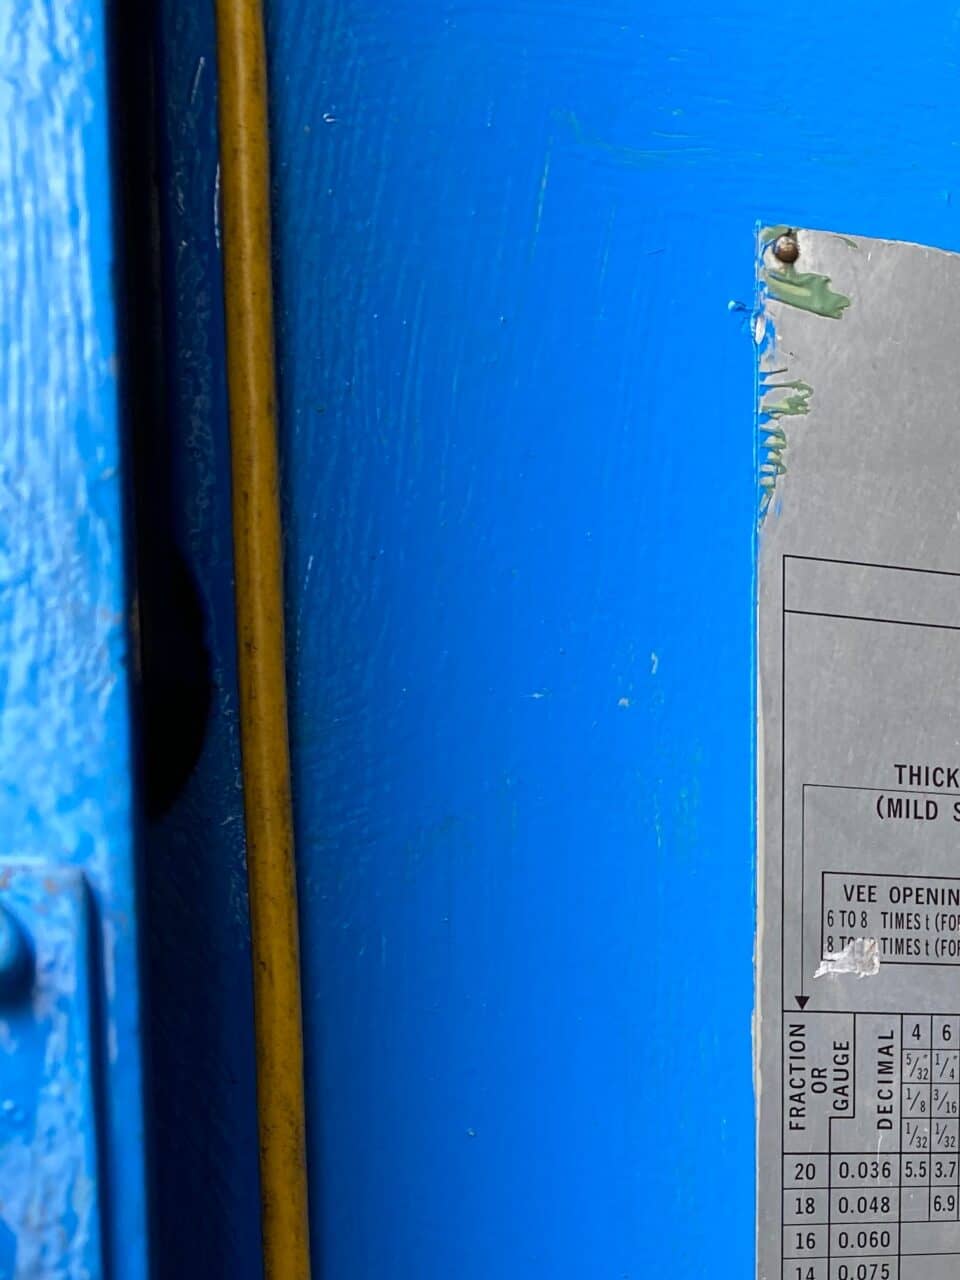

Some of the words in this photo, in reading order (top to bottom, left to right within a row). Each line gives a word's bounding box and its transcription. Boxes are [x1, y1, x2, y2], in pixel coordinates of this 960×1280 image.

[876, 795, 938, 820] (MILD
[843, 884, 877, 903] VEE
[827, 909, 834, 927] 6
[839, 910, 856, 928] TO
[860, 910, 868, 928] 8
[880, 911, 921, 930] TIMES
[925, 913, 930, 931] t
[827, 935, 834, 953] 8
[880, 937, 921, 956] TIMES
[925, 939, 930, 957] t
[912, 1023, 921, 1040] 4
[942, 1024, 951, 1041] 6
[789, 1024, 806, 1130] FRACTION
[811, 1067, 828, 1094] OR
[832, 1041, 849, 1111] GAUGE
[876, 1030, 894, 1130] DECIMAL
[795, 1163, 816, 1180] 20
[839, 1161, 891, 1179] 0.036
[905, 1161, 926, 1178] 5.5
[935, 1161, 956, 1178] 3.7
[795, 1197, 815, 1215] 18
[838, 1196, 890, 1214] 0.048
[934, 1195, 955, 1212] 6.9
[796, 1232, 816, 1250] 16
[838, 1230, 890, 1249] 0.060
